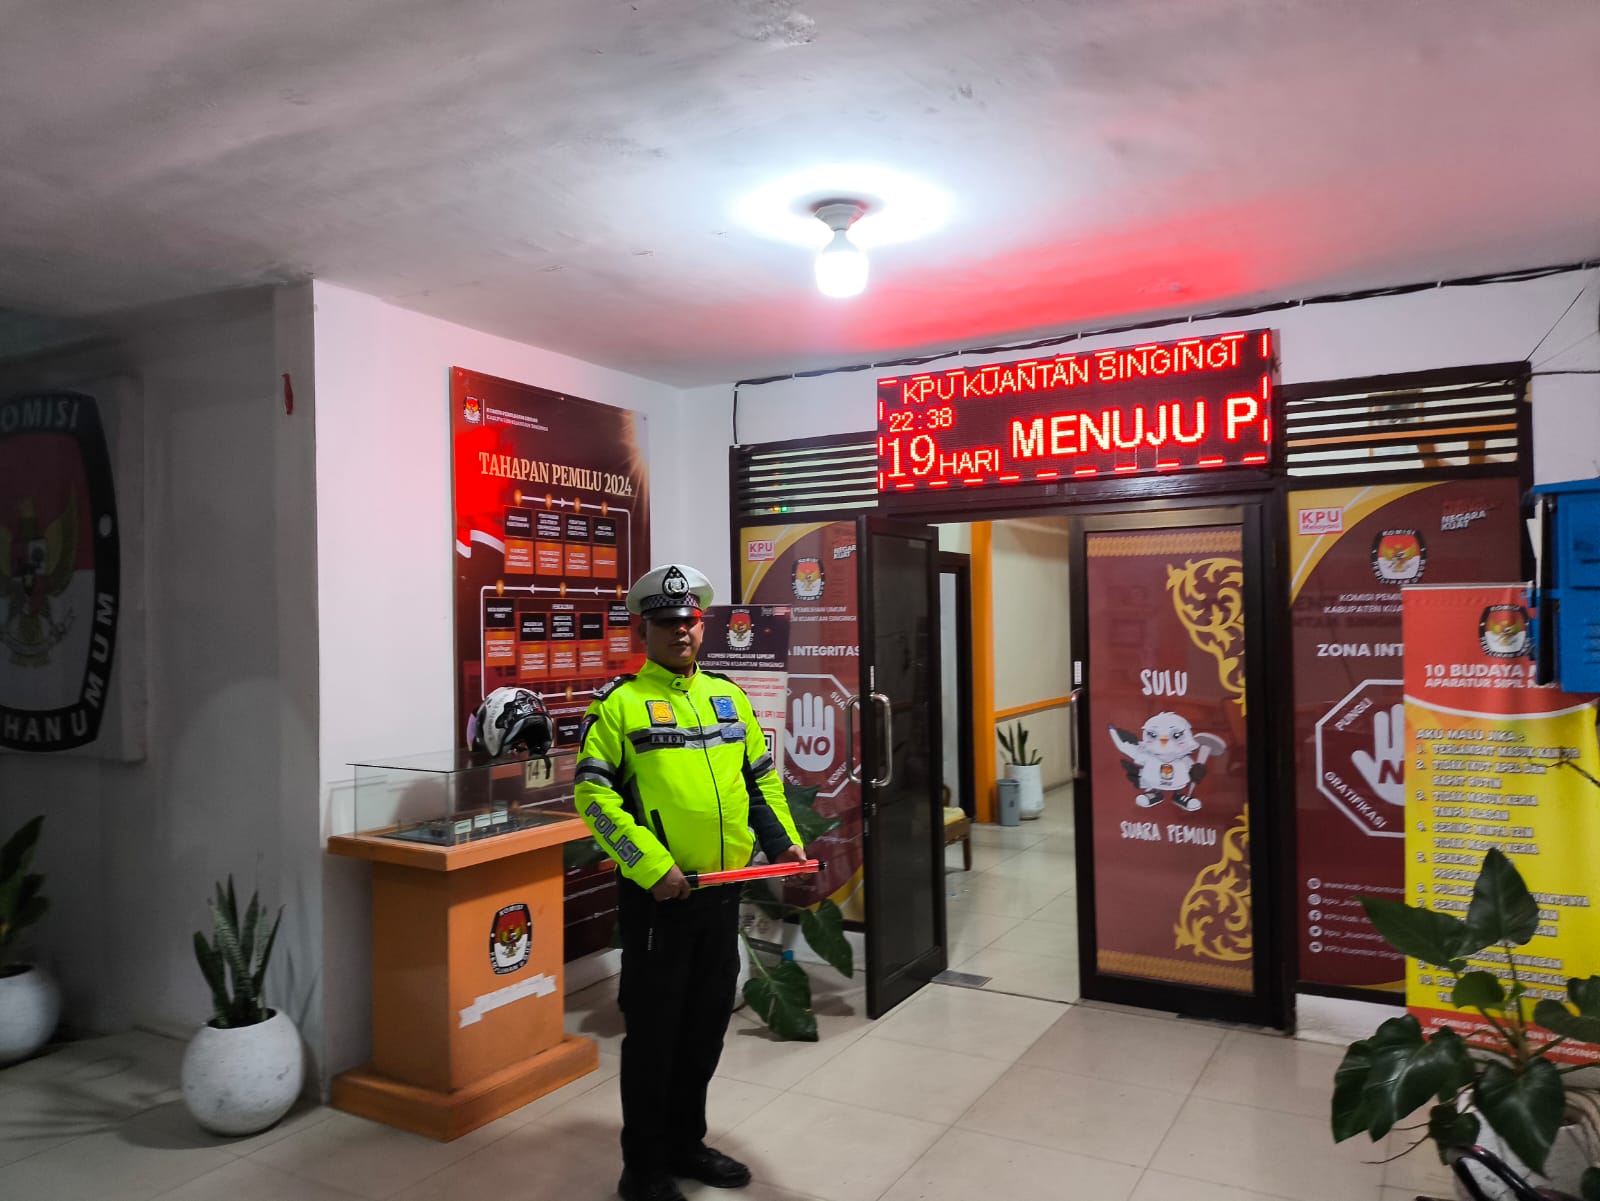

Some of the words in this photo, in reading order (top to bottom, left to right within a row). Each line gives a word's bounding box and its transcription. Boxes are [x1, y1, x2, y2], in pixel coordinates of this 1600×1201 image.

[903, 377, 955, 404] KPU
[963, 359, 1088, 398] KUANTAN
[0, 397, 79, 432] OMISI
[889, 406, 953, 432] 22:38
[1012, 402, 1205, 459] MENUJU
[1227, 397, 1258, 440] P
[888, 434, 936, 478] 19
[939, 448, 999, 475] HARI
[478, 451, 550, 484] TAHAPAN
[551, 463, 603, 492] PEMILU
[603, 472, 633, 497] 2024
[1302, 510, 1340, 524] KPU
[749, 543, 773, 553] KPU
[1317, 643, 1371, 657] ZONA
[1374, 643, 1405, 657] INT
[1140, 668, 1188, 697] SULU
[1424, 664, 1445, 677] 10
[1450, 664, 1525, 678] BUDAYA
[1424, 679, 1491, 688] APARATUR
[795, 735, 832, 756] NO
[1324, 771, 1388, 829] GRATIFIKASI
[585, 801, 645, 869] POLISI
[1119, 820, 1161, 842] SUARA
[1166, 824, 1217, 847] PEMILU
